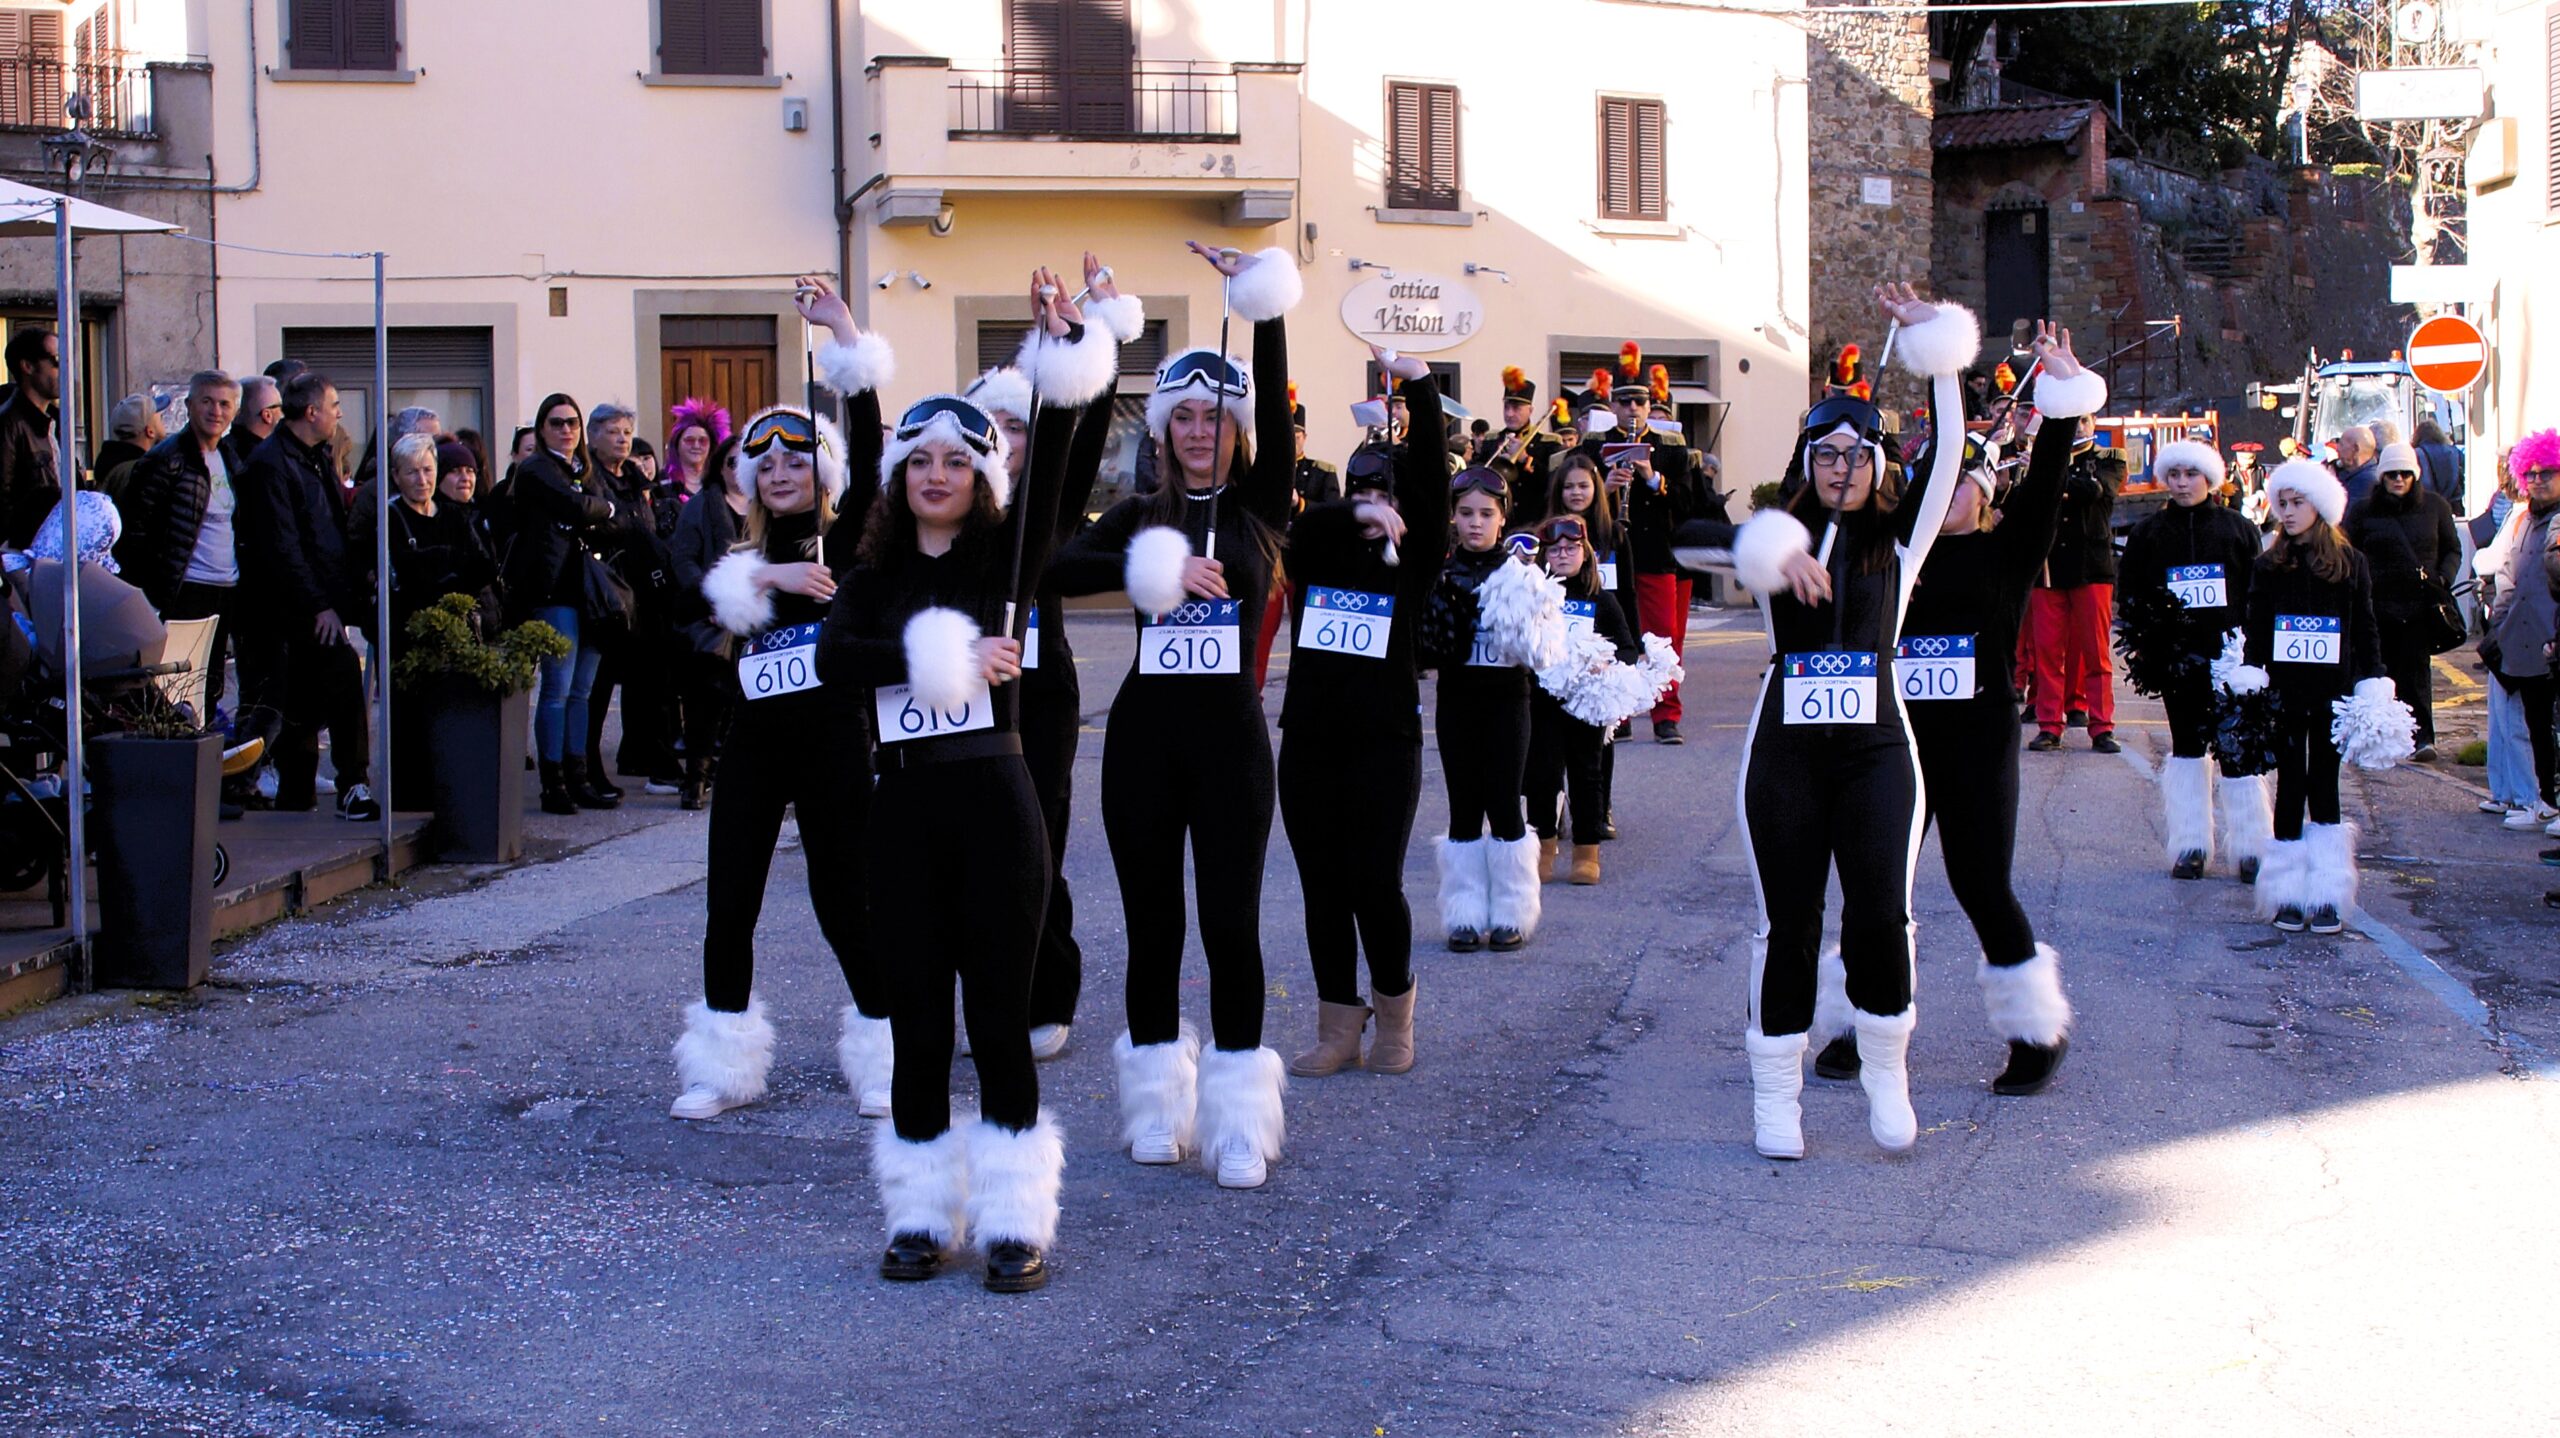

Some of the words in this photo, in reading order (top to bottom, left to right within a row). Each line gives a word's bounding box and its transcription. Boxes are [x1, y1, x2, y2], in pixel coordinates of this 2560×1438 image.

[1389, 278, 1441, 300] ottica
[1374, 303, 1445, 333] Vision
[2180, 585, 2217, 606] 610
[1316, 619, 1373, 652] 610
[2286, 638, 2328, 660] 610
[1159, 637, 1222, 670] 610
[755, 656, 807, 693] 610
[1905, 667, 1958, 697] 610
[899, 696, 970, 734] 610
[1801, 687, 1861, 720] 610
